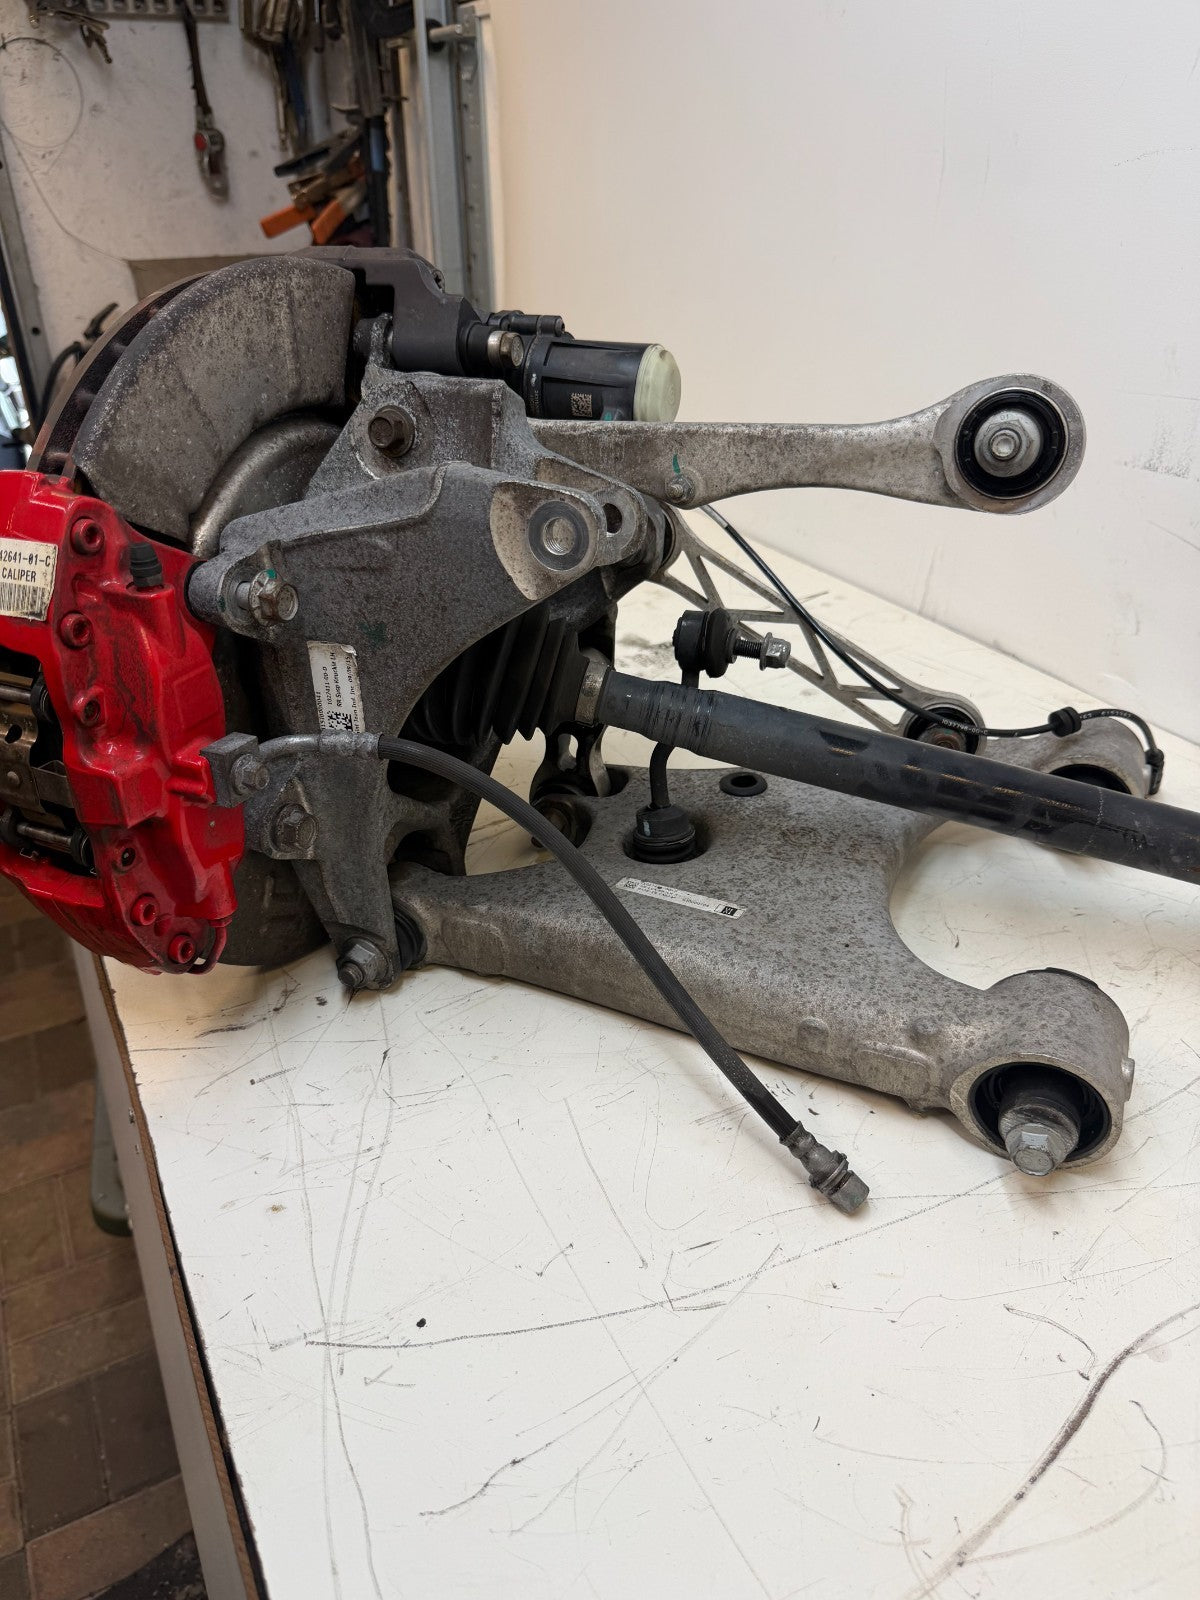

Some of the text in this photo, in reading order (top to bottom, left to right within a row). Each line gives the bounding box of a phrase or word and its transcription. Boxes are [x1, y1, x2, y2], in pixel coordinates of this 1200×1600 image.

[1, 568, 37, 583] CALIPER
[330, 652, 336, 660] LH
[331, 662, 339, 684] Knuckle
